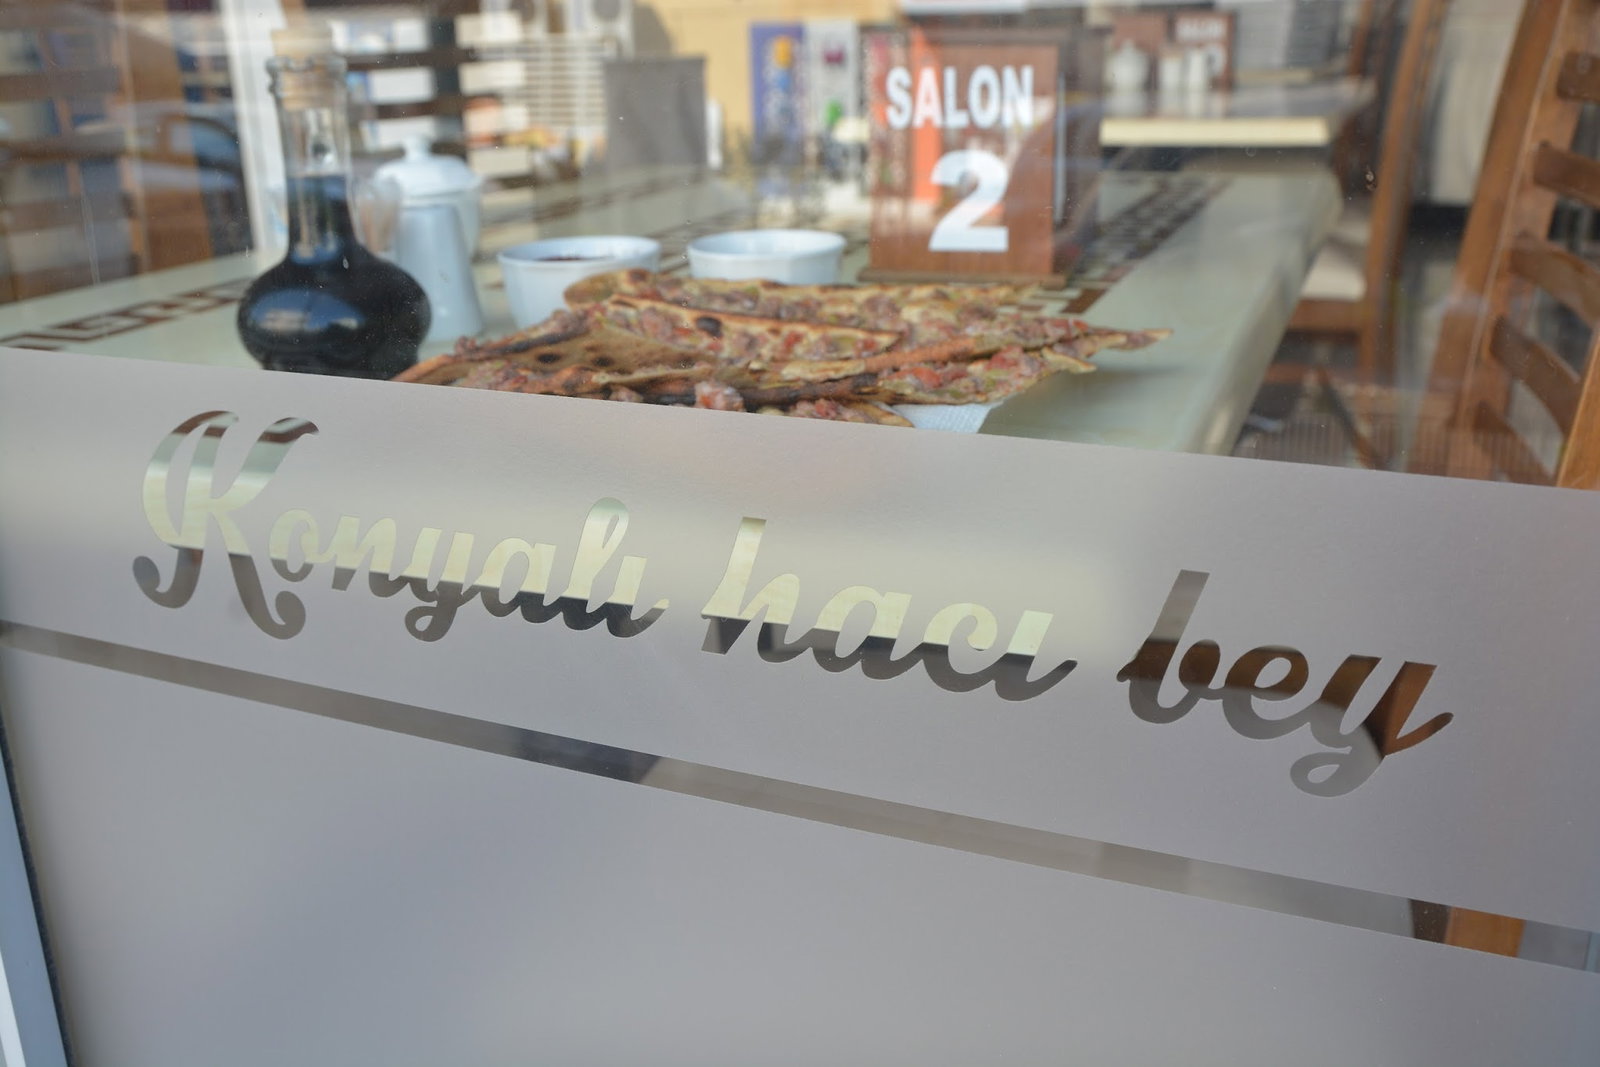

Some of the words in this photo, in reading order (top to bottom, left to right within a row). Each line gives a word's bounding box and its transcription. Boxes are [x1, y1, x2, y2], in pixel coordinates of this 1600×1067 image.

[886, 65, 1034, 128] SALON
[929, 149, 1010, 253] 2
[132, 410, 670, 642] Konyalı
[701, 516, 1078, 702] hacı
[1116, 569, 1455, 798] bey
